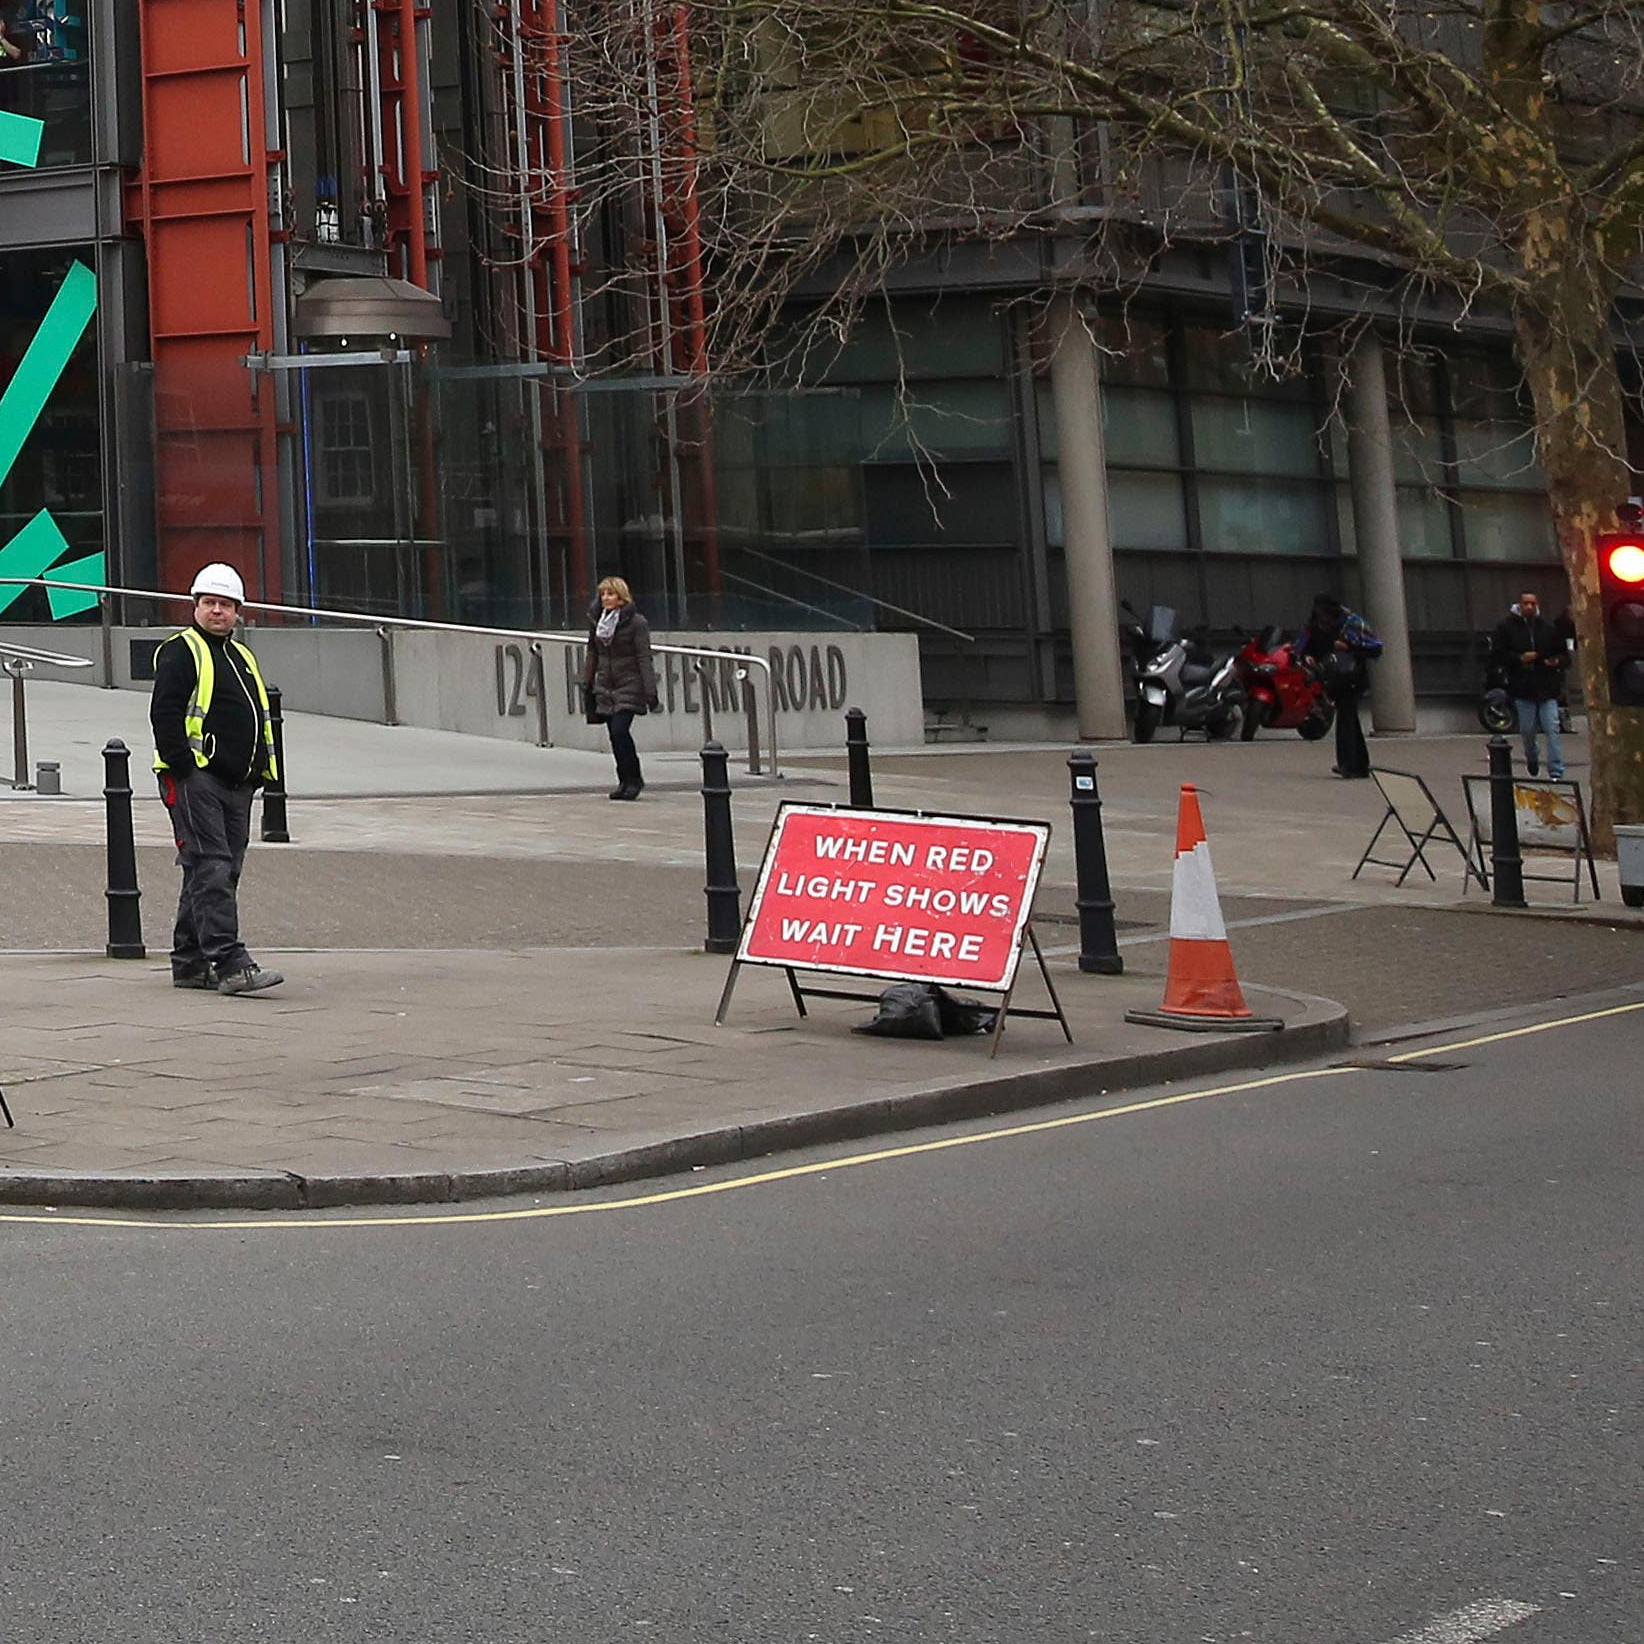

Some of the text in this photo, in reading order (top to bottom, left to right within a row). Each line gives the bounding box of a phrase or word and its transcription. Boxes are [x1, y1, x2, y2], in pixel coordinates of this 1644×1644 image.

[769, 645, 847, 712] ROAD
[815, 835, 994, 872] WHEN RED
[777, 872, 1010, 916] LIGHT SHOWS
[781, 918, 984, 961] WAIT HERE
